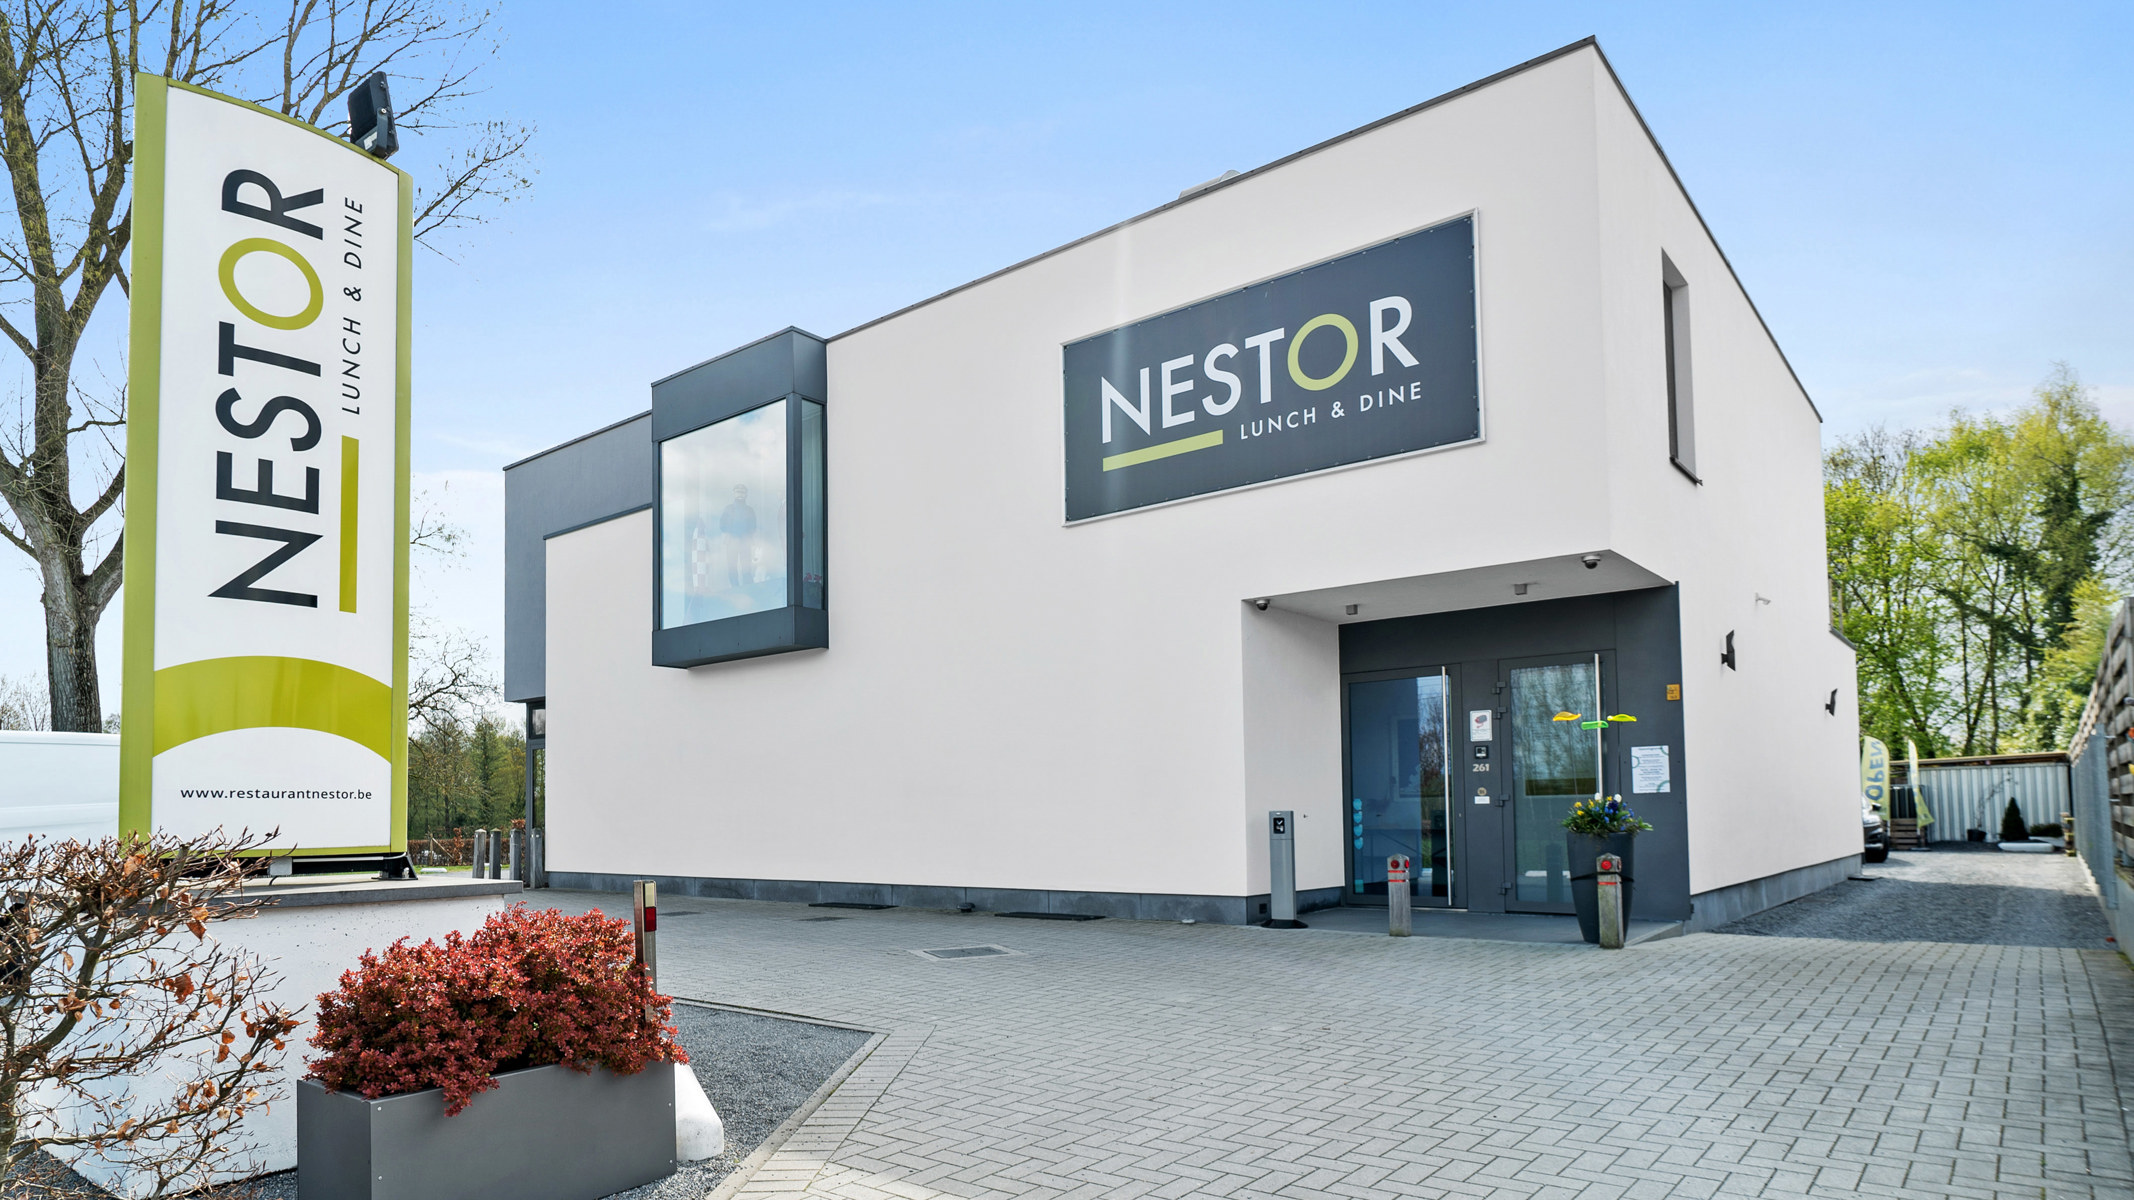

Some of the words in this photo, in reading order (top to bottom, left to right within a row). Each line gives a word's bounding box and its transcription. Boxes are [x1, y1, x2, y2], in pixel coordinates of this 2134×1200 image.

[344, 197, 364, 270] DINE
[344, 287, 362, 302] &
[207, 168, 324, 608] NESTOR
[342, 317, 361, 415] LUNCH
[1101, 295, 1420, 444] NESTOR
[1240, 406, 1316, 440] LUNCH
[1331, 401, 1345, 418] &
[1360, 381, 1422, 412] DINE
[180, 789, 372, 800] www.restaurantnestor.be
[1472, 763, 1490, 772] 261
